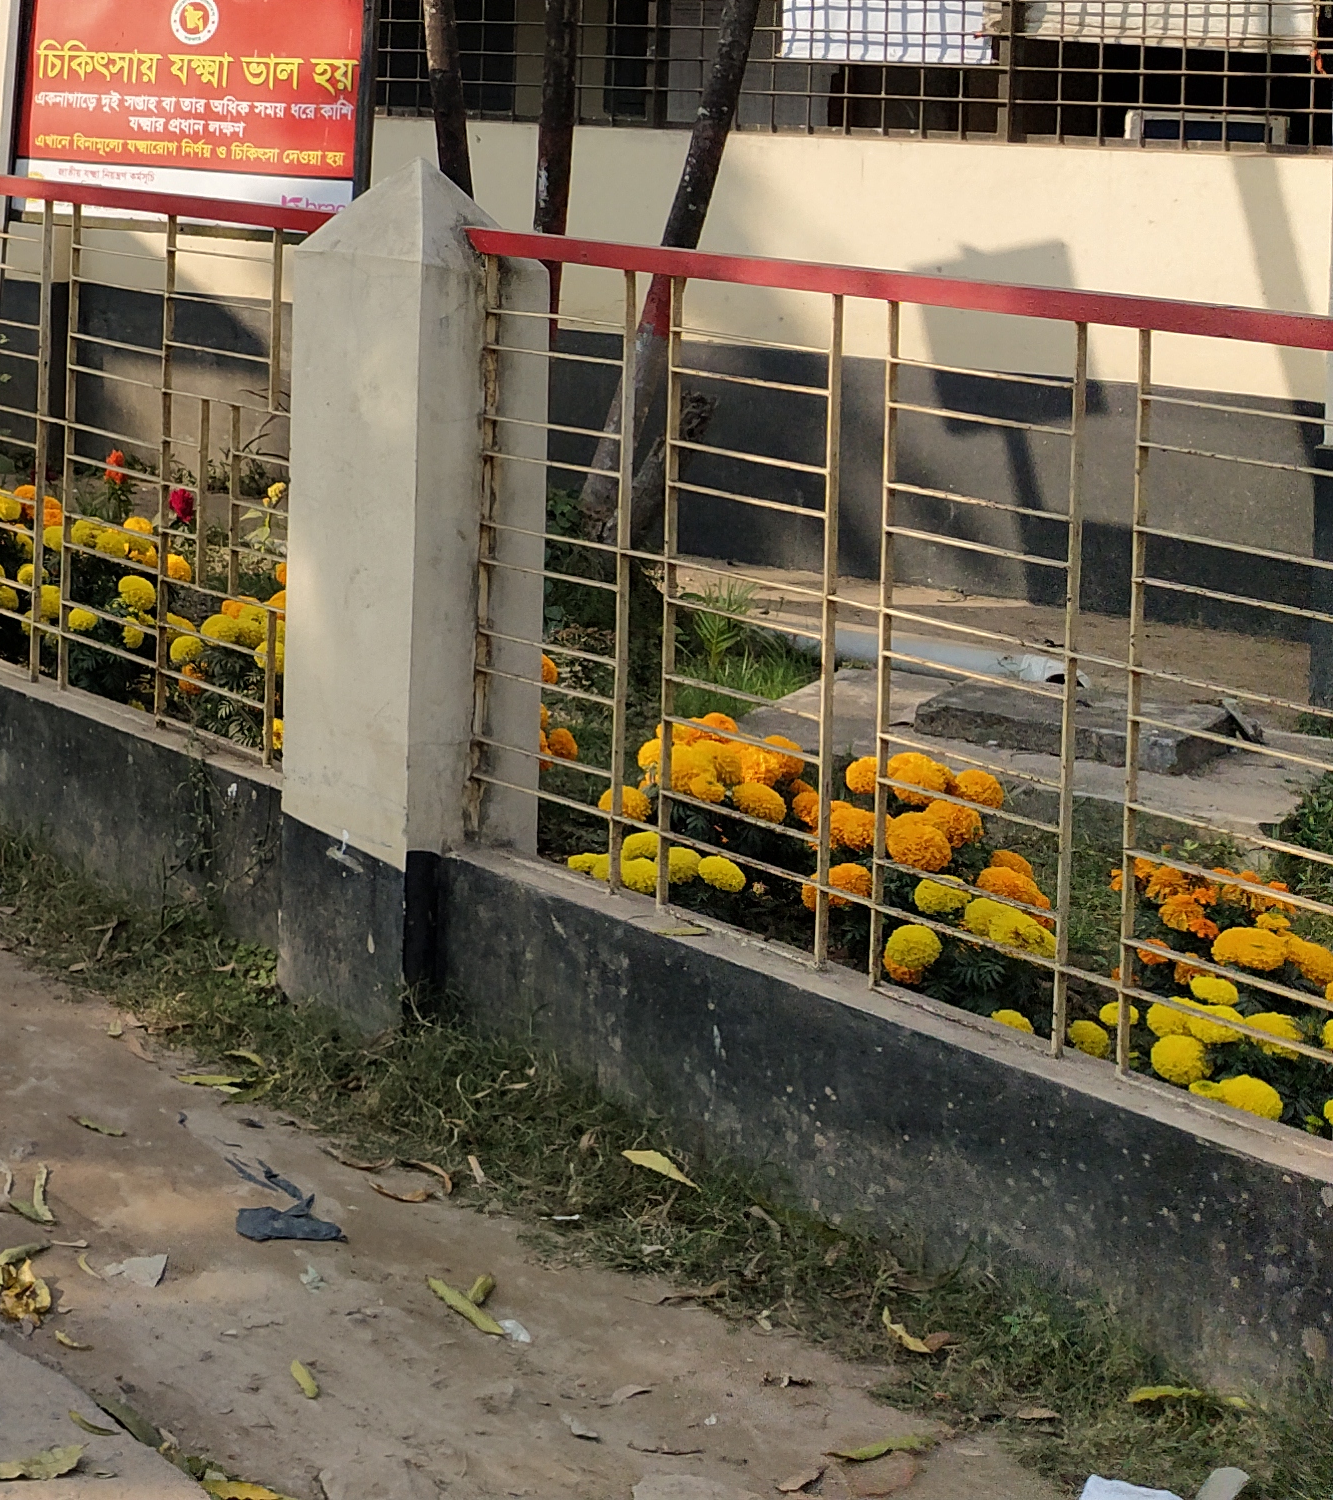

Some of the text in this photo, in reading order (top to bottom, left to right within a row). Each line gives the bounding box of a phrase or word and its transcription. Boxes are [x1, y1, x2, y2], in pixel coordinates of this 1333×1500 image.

[36, 39, 360, 95] চিকিৎসায় যক্ষ্মা ভাল হয়
[34, 90, 355, 121] একনাগাড়ে দুই সপ্তাহ বা তার অধিক সময় ধরে কাশি
[167, 117, 206, 136] প্রধান
[207, 120, 247, 138] লক্ষণ
[34, 133, 71, 150] এখানে
[73, 132, 123, 156] বিনামূল্যে
[181, 137, 213, 159] নির্ণয়
[216, 144, 227, 159] ও
[231, 141, 280, 164] চিকিৎসা
[282, 150, 324, 166] দেওয়া
[325, 151, 345, 167] হয়
